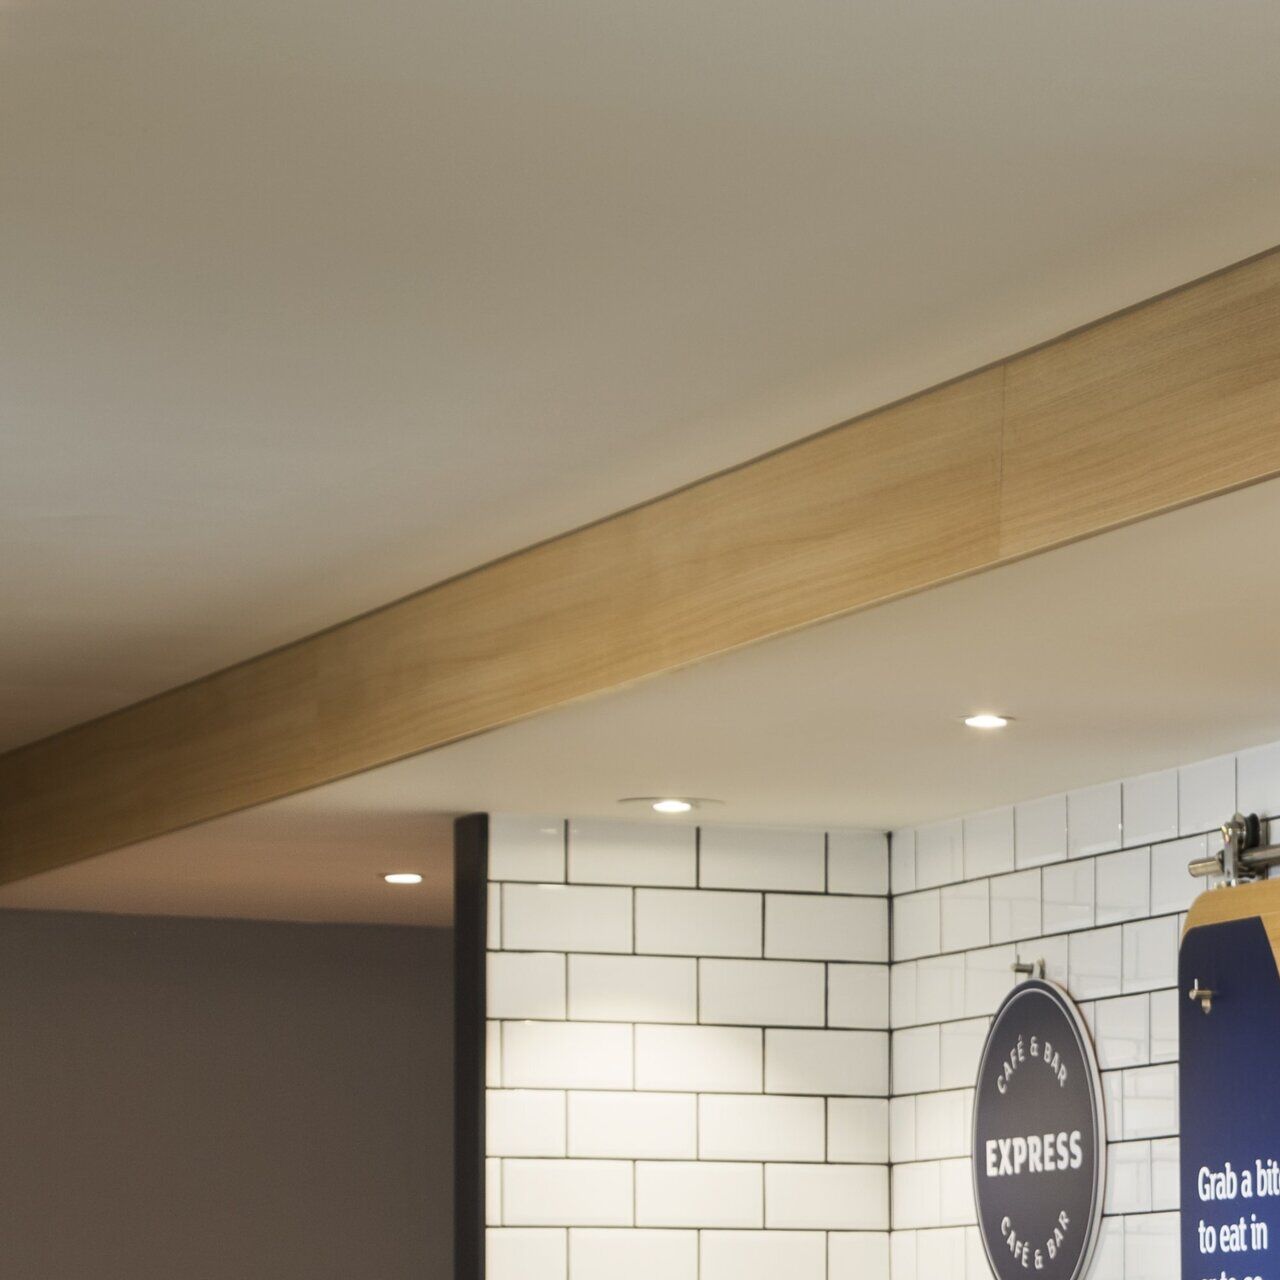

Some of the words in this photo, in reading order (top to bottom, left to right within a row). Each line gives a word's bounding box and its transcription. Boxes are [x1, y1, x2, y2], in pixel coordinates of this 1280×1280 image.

[997, 1034, 1025, 1094] CAFÉ
[1030, 1036, 1039, 1056] &
[1043, 1041, 1068, 1088] BAR
[986, 1130, 1083, 1177] EXPRESS
[1198, 1162, 1238, 1201] Grab
[1241, 1170, 1253, 1198] a
[1001, 1216, 1030, 1268] CAFÉ
[1034, 1249, 1044, 1270] &
[1046, 1210, 1070, 1259] BAR
[1198, 1220, 1216, 1254] to
[1220, 1217, 1248, 1252] eat
[1250, 1214, 1268, 1250] in
